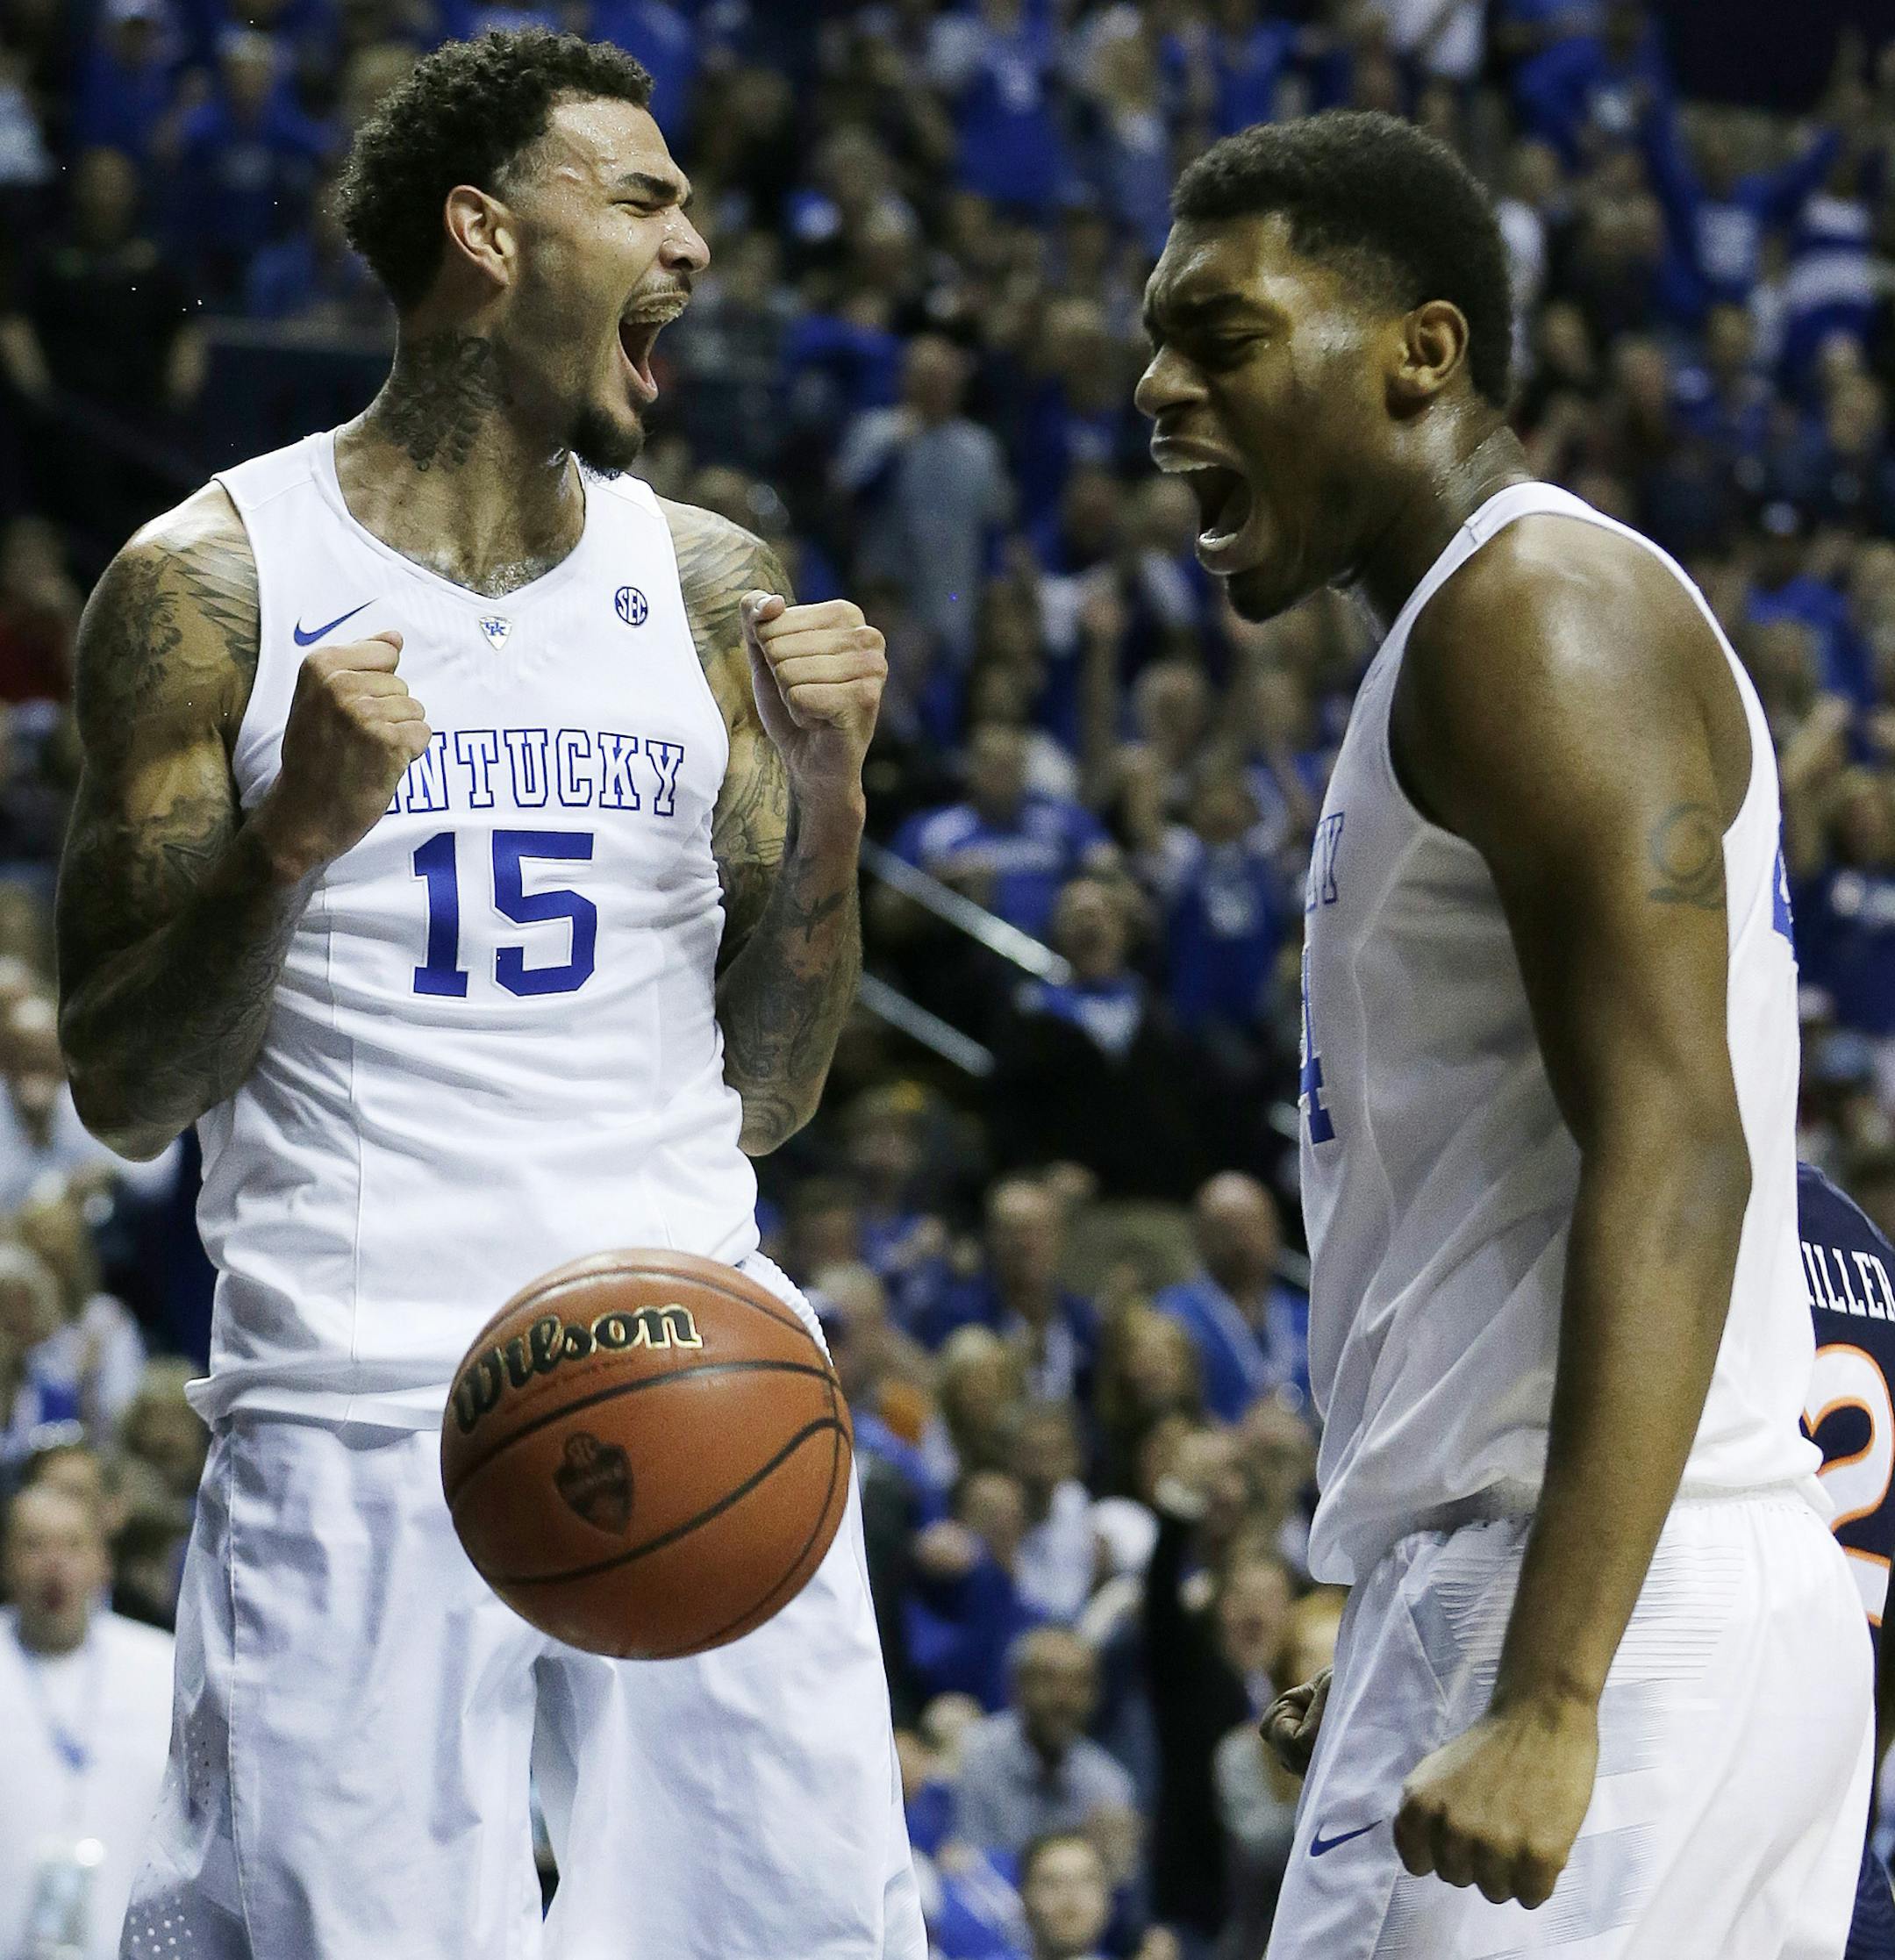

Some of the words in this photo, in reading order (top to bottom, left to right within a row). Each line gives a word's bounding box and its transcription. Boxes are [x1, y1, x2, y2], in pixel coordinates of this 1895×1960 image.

[615, 586, 648, 626] SEC
[384, 729, 684, 816] NTUCKY
[412, 829, 597, 998] 15
[1801, 1240, 1895, 1322] ILLER
[452, 1303, 703, 1434] Wilson
